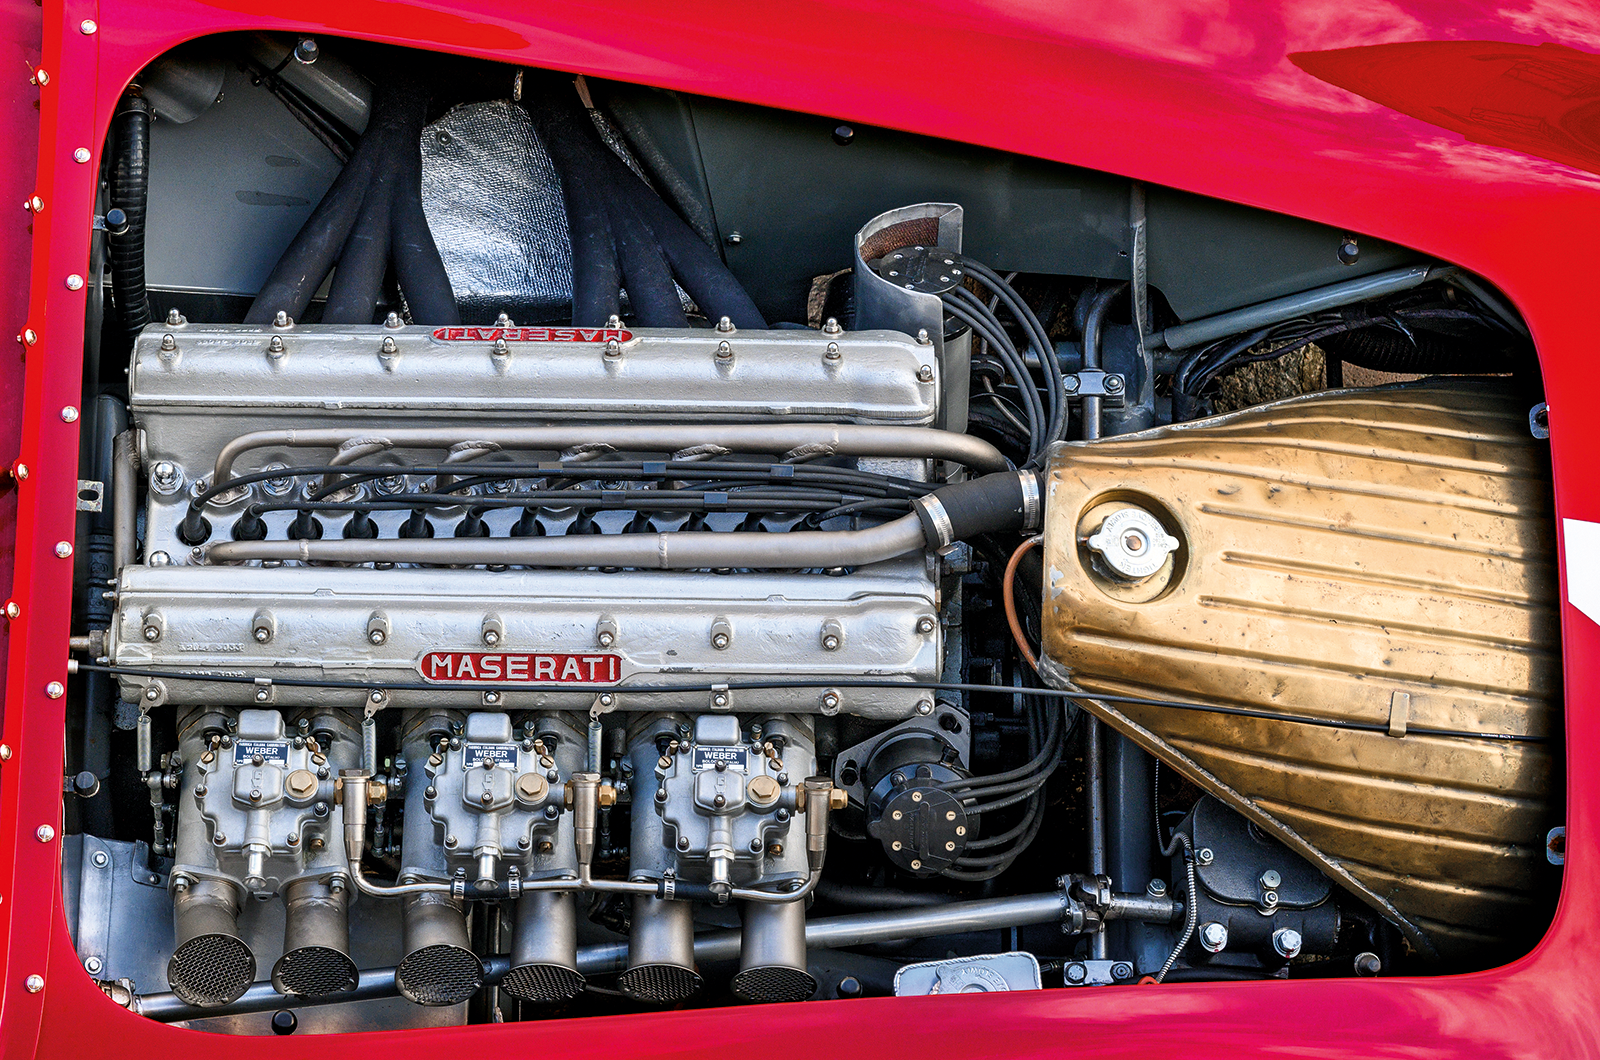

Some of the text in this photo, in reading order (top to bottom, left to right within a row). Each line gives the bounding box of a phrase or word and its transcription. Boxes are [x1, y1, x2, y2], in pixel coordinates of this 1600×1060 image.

[444, 327, 623, 342] MASERATI
[1106, 511, 1129, 533] SLOWLY
[1118, 562, 1157, 575] TIGHTEN
[431, 654, 615, 680] MASERATI
[245, 747, 279, 755] WEBER
[475, 750, 508, 758] WEBER
[704, 751, 738, 760] WEBER
